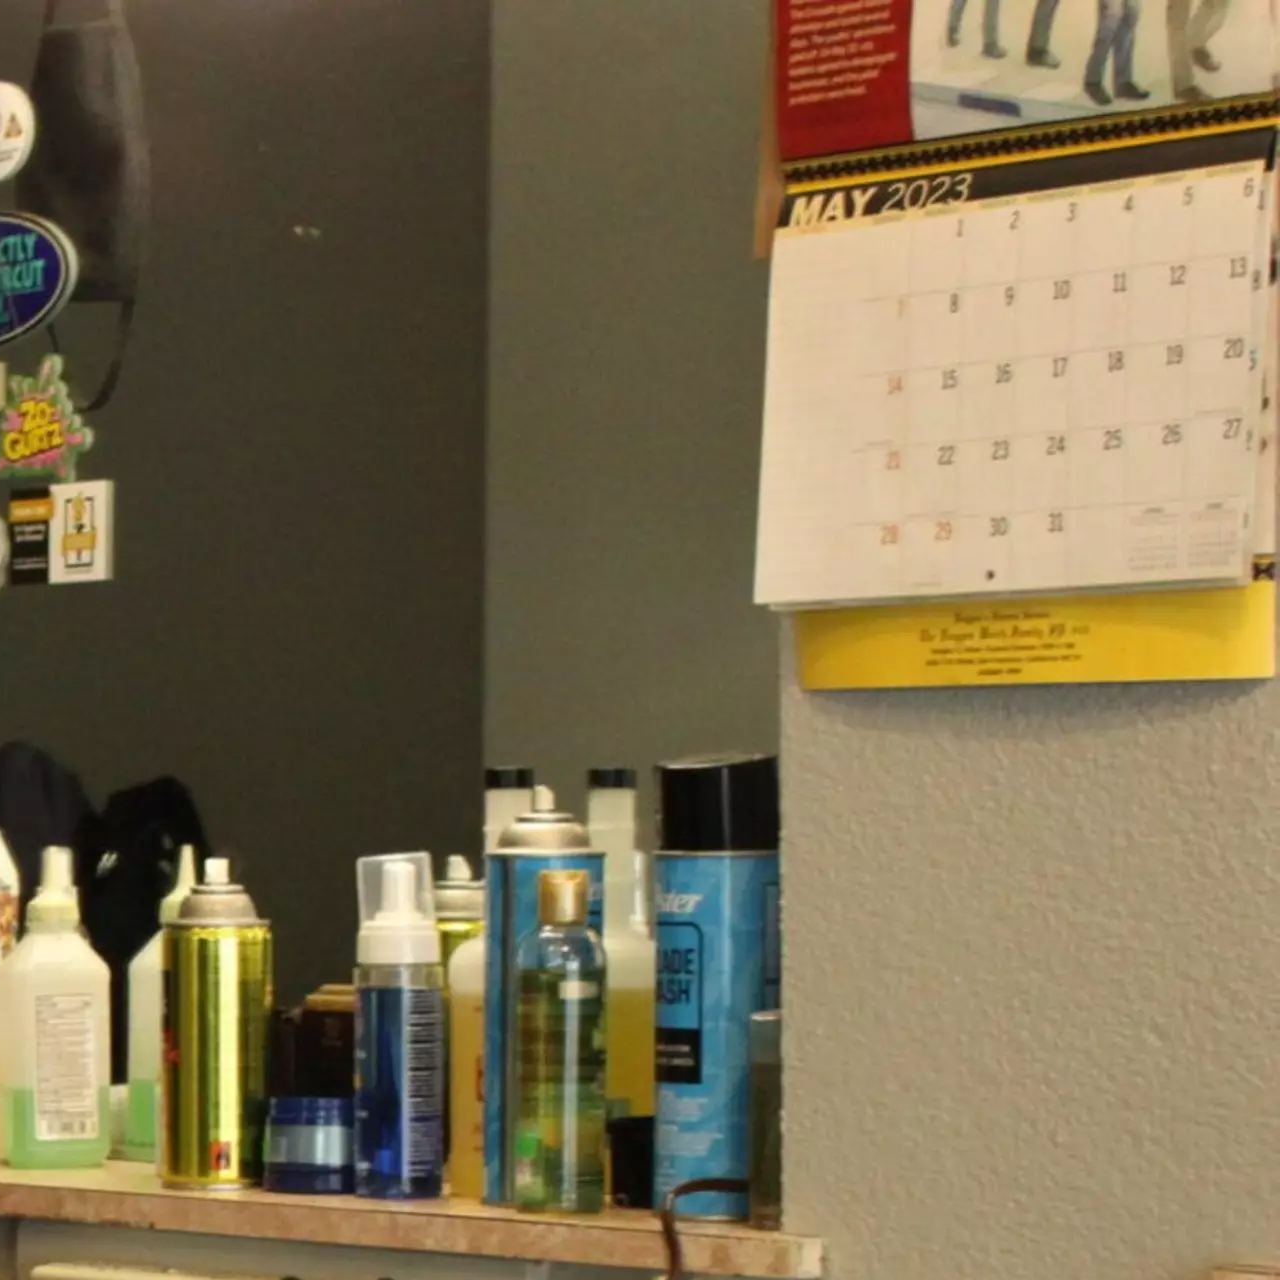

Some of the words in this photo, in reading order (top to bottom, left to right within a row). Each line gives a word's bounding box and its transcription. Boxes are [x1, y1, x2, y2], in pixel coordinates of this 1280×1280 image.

[790, 186, 879, 227] MAY
[881, 172, 974, 214] 2023
[1009, 209, 1021, 230] 2
[1066, 202, 1078, 223] 3
[1122, 193, 1134, 212] 4
[1183, 185, 1194, 206] 5
[1243, 178, 1255, 198] 6
[949, 293, 959, 314] 8
[1004, 286, 1015, 307] 9
[1052, 279, 1071, 300] 10
[1112, 272, 1128, 293] 11
[1169, 265, 1187, 286] 12
[1229, 257, 1247, 279] 13
[941, 369, 958, 391] 15
[995, 362, 1012, 384] 16
[1051, 357, 1068, 379] 17
[1107, 350, 1124, 373] 18
[1165, 344, 1184, 366] 19
[1223, 337, 1244, 360] 20
[937, 445, 956, 466] 22
[992, 439, 1010, 461] 23
[1045, 435, 1066, 456] 24
[1102, 428, 1122, 451] 25
[1161, 423, 1181, 445] 26
[1222, 417, 1243, 440] 27
[880, 524, 899, 546] 28
[934, 520, 953, 541] 29
[989, 516, 1008, 538] 30
[1047, 511, 1064, 534] 31
[656, 888, 705, 913] ster
